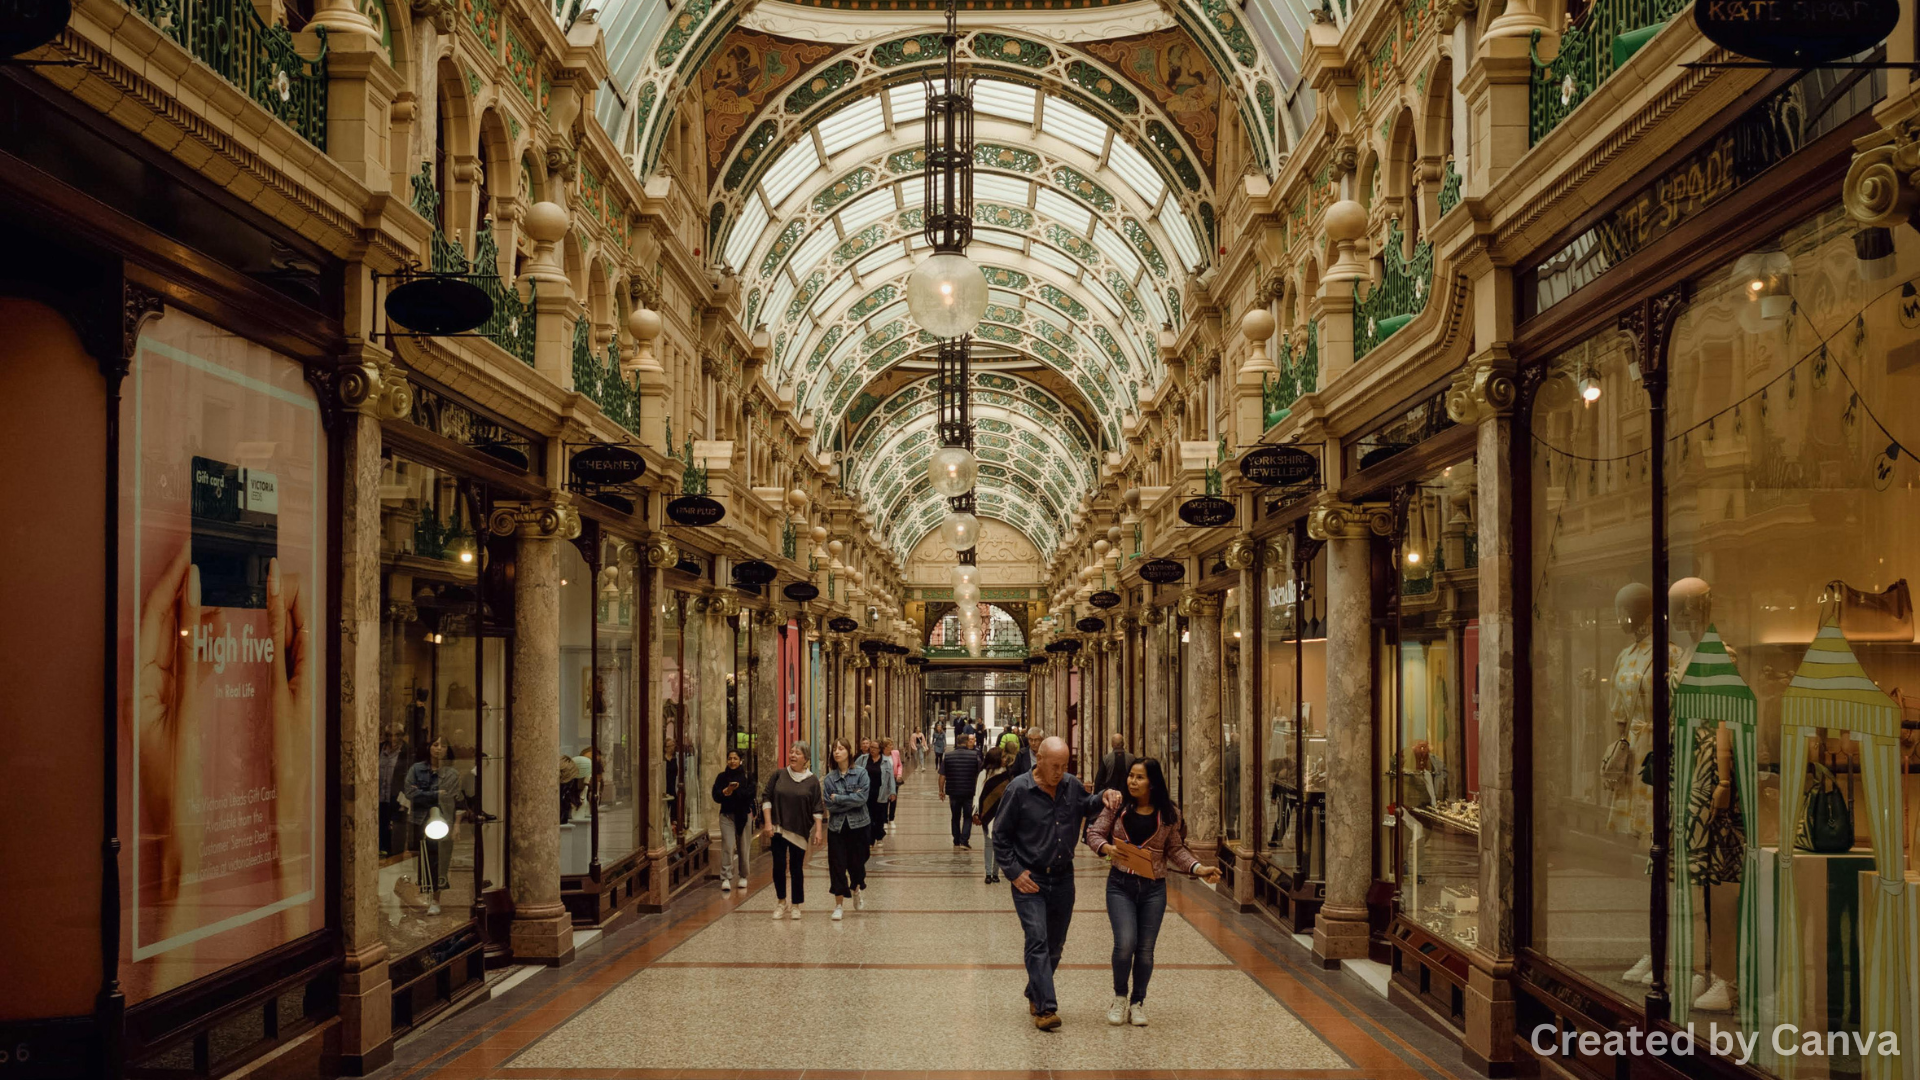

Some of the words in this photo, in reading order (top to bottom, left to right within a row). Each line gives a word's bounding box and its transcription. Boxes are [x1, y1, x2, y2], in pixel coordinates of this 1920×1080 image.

[1708, 0, 1782, 21] KATE
[1659, 138, 1735, 227] SPADE
[576, 460, 639, 471] CHEANEY
[1247, 454, 1309, 465] YORKSHIRE
[196, 470, 209, 485] Gift
[209, 474, 225, 488] card
[1247, 467, 1309, 477] JEWELLERY
[250, 479, 274, 493] VICTORIA
[193, 622, 237, 674] High
[242, 623, 274, 663] five
[215, 684, 223, 698] In
[225, 683, 241, 698] Real
[242, 682, 255, 698] Life
[202, 796, 228, 812] Victoria
[229, 791, 247, 807] Leeds
[248, 787, 260, 805] Gift
[205, 812, 237, 833] Available
[237, 811, 252, 827] from
[253, 807, 263, 825] the
[198, 841, 230, 858] Customer
[231, 834, 253, 850] Service
[254, 828, 269, 844] Desk
[200, 861, 219, 878] online
[220, 861, 227, 875] at
[228, 844, 280, 871] victorialeeds.co.uk
